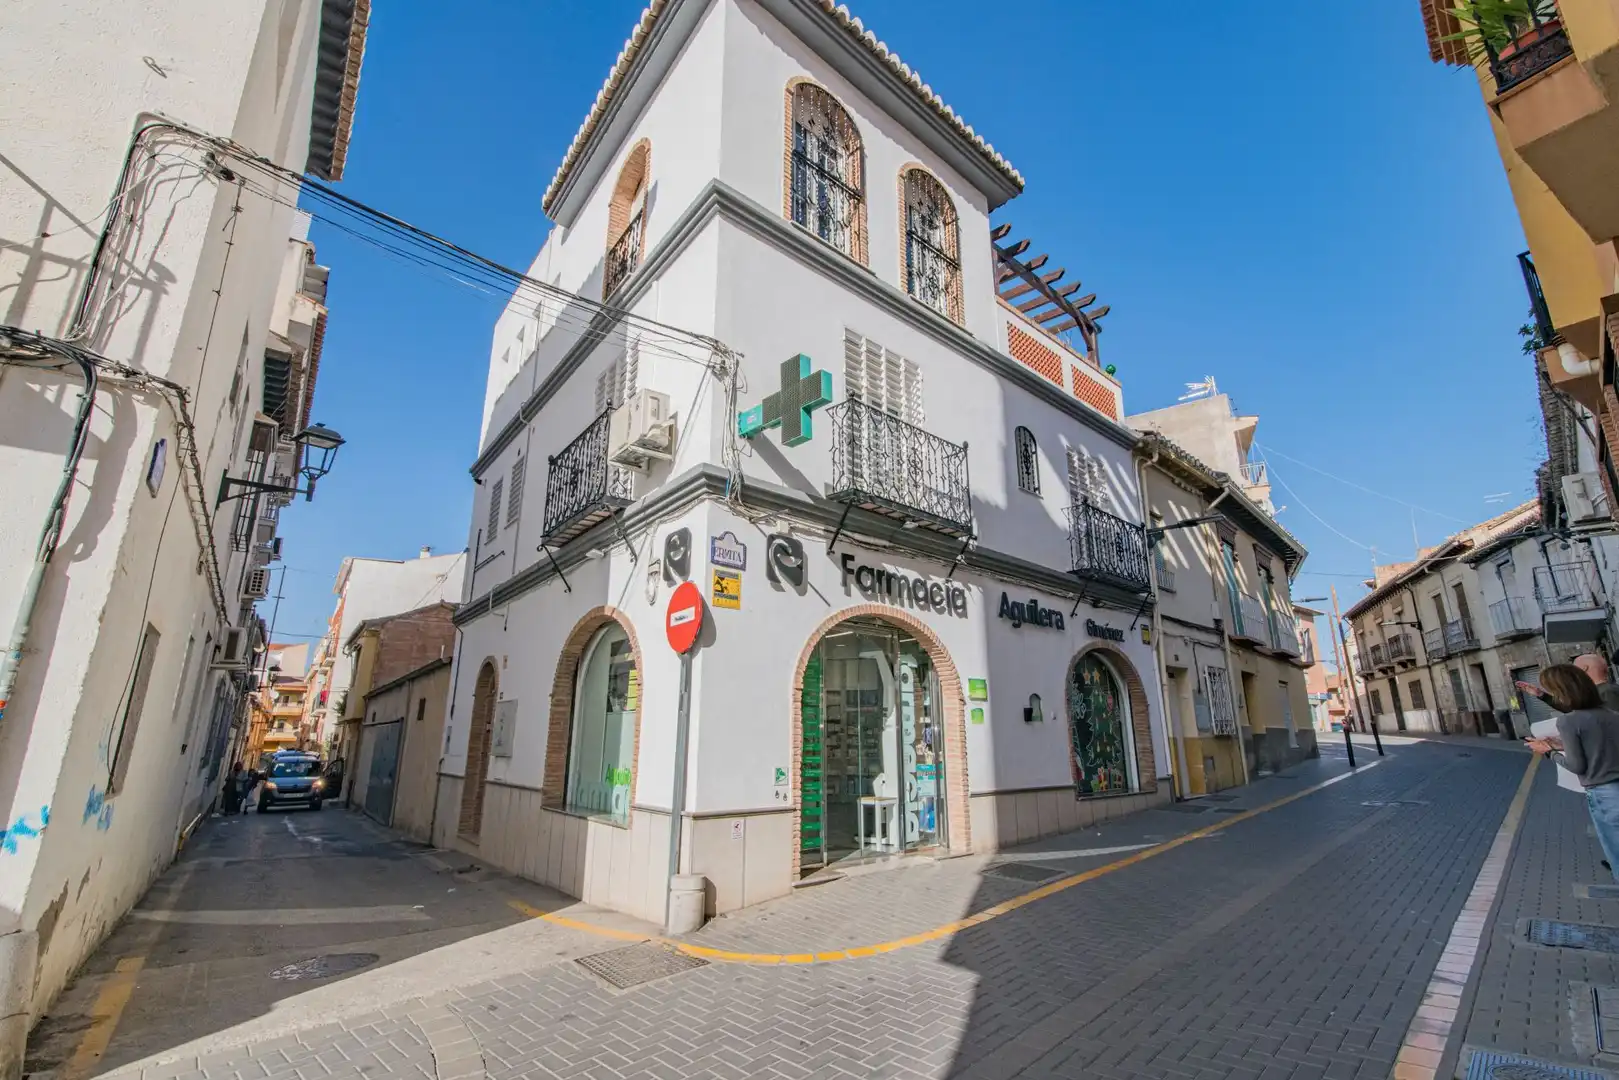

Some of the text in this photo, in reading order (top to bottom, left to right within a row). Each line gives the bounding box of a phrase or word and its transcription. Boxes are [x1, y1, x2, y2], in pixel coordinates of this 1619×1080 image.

[714, 546, 742, 562] ERMITA
[840, 552, 968, 614] Farmacia
[998, 591, 1066, 630] Aguilera
[1086, 618, 1126, 642] Giménez
